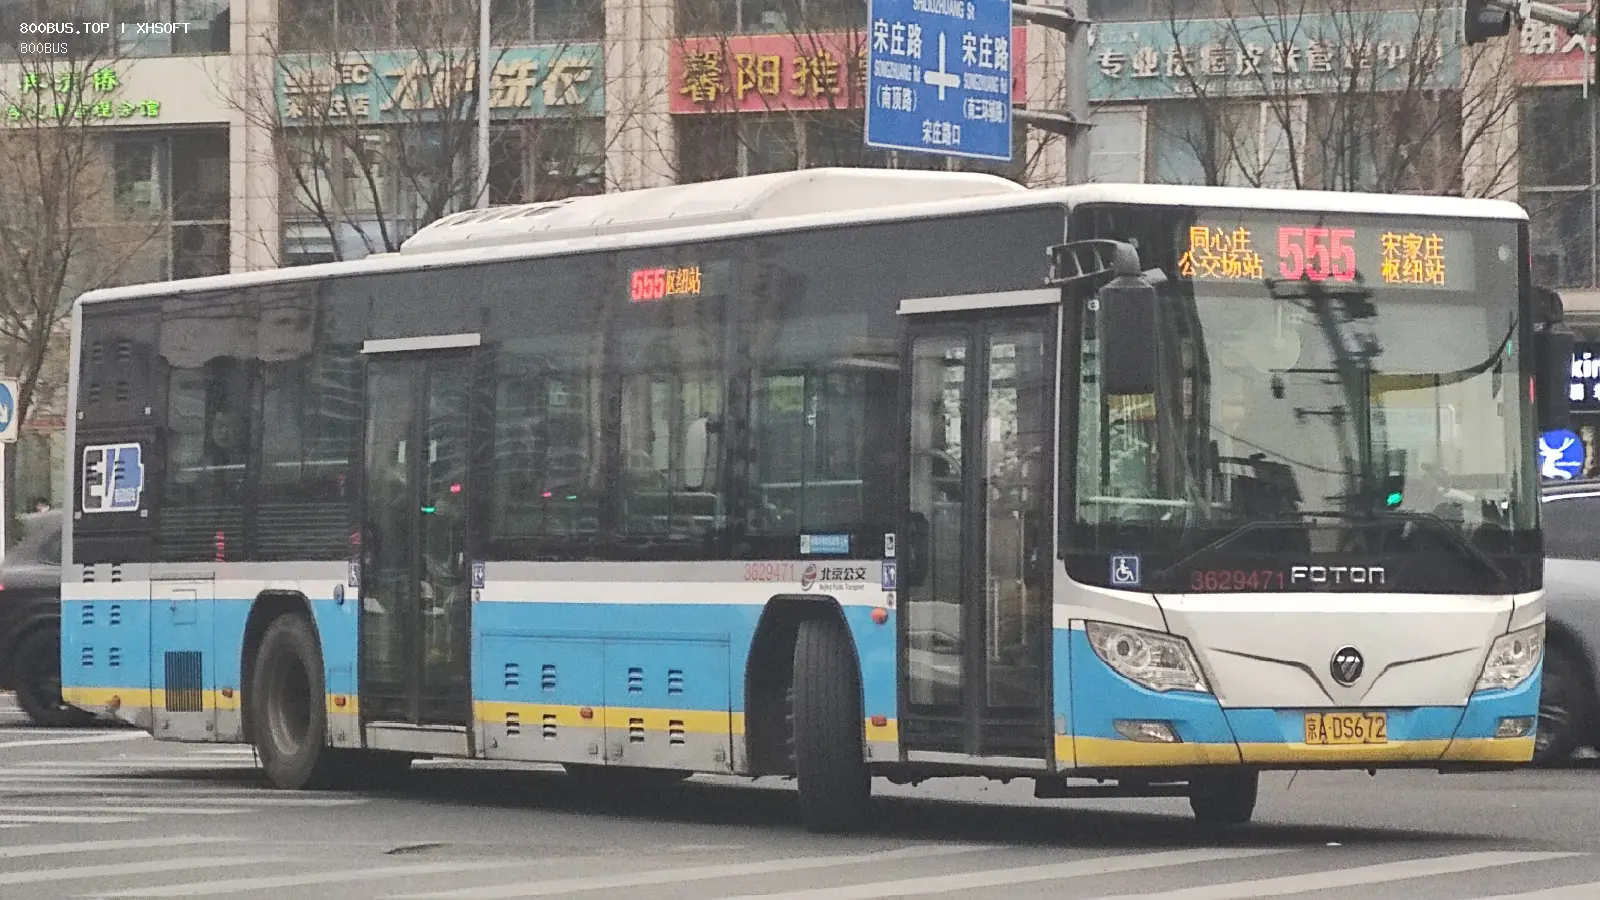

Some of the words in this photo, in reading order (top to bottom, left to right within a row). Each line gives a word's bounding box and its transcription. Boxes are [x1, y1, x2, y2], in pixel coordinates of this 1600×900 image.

[873, 18, 923, 60] 宋庄路
[962, 31, 1009, 72] 宋庄路
[679, 48, 868, 102] 馨阳雅
[922, 120, 961, 146] 宋庄路口
[1189, 226, 1252, 252] 同心庄
[1380, 231, 1444, 259] 宋家庄
[1178, 251, 1263, 279] 公交场站
[1277, 226, 1356, 282] 555
[631, 268, 665, 300] 555
[1380, 258, 1445, 285] 枢纽站
[744, 563, 795, 581] 3629471
[820, 567, 867, 581] 北京公交
[1191, 571, 1285, 591] 3629471
[1290, 565, 1386, 584] FOTON
